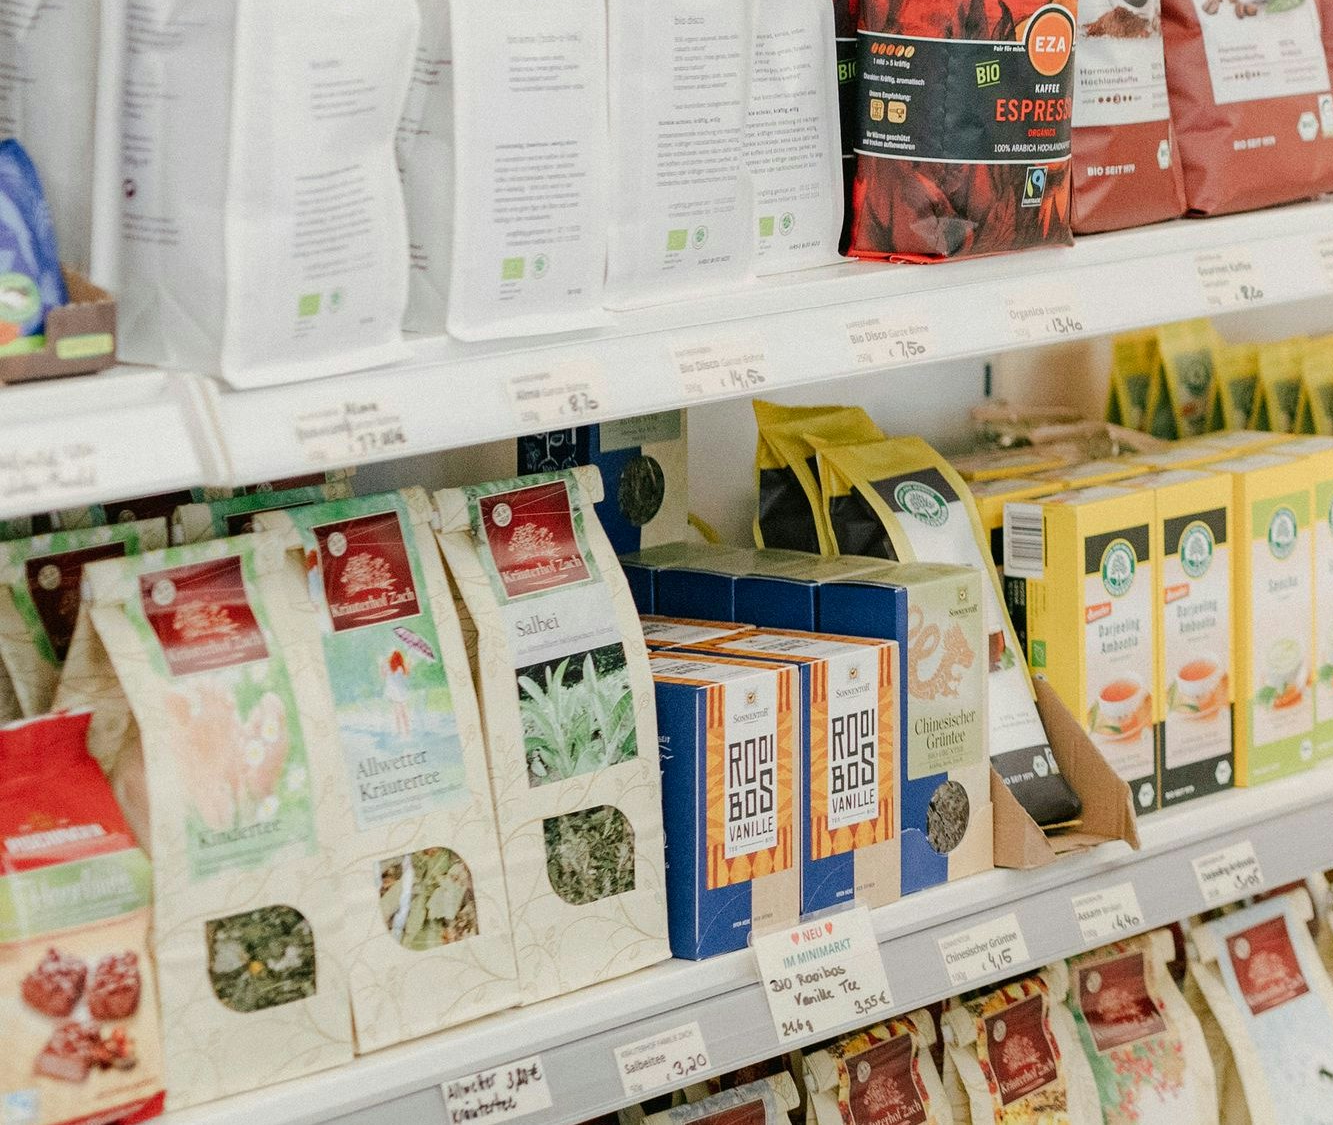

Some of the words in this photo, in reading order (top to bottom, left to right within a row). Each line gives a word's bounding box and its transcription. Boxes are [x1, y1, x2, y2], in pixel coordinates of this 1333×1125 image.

[1035, 36, 1066, 53] EZA
[896, 75, 925, 87] aromatisch
[976, 64, 1000, 85] BIO
[881, 90, 911, 103] Empfehlung:
[1035, 83, 1060, 94] KAFFEE
[883, 140, 915, 152] aufbewahren
[886, 132, 911, 144] geschützt
[994, 143, 1011, 153] 100%
[1011, 143, 1037, 153] ARABICA
[1009, 306, 1044, 321] Organico
[1052, 316, 1082, 333] 13,40
[850, 333, 864, 344] Bio
[865, 331, 888, 342] Disco
[896, 339, 926, 358] 7,50
[680, 362, 695, 373] Bio
[695, 359, 720, 372] Disco
[730, 368, 766, 388] 14,50
[503, 562, 555, 584] Kräuterhof
[556, 555, 582, 572] Zach
[331, 595, 387, 617] Kräuterhof
[387, 588, 417, 607] Zach
[516, 613, 561, 639] Salbei
[1098, 619, 1141, 639] Darjeeling
[914, 709, 976, 736] Chinesischer
[831, 708, 876, 762] ROOI
[926, 729, 967, 752] Grüntee
[356, 750, 428, 781] Allwetter
[728, 733, 774, 789] ROOI
[831, 741, 876, 795] BOS
[359, 770, 440, 802] Kräutertee
[728, 768, 774, 823] BOS
[831, 787, 876, 815] VANILLE
[729, 817, 774, 842] VANILLE
[1077, 907, 1102, 922] Assam
[802, 926, 823, 944] NEU
[783, 955, 797, 970] IM
[798, 938, 852, 965] MINIMARKT
[945, 942, 989, 965] Chinesischer
[988, 930, 1019, 950] Grüntee
[988, 948, 1014, 970] 4,15
[799, 965, 847, 987] Rooibos
[793, 988, 835, 1008] Vanille
[838, 979, 862, 996] Tee
[624, 1053, 666, 1075] Salbeitee
[673, 1052, 708, 1077] 3,20
[900, 1100, 923, 1121] Zach
